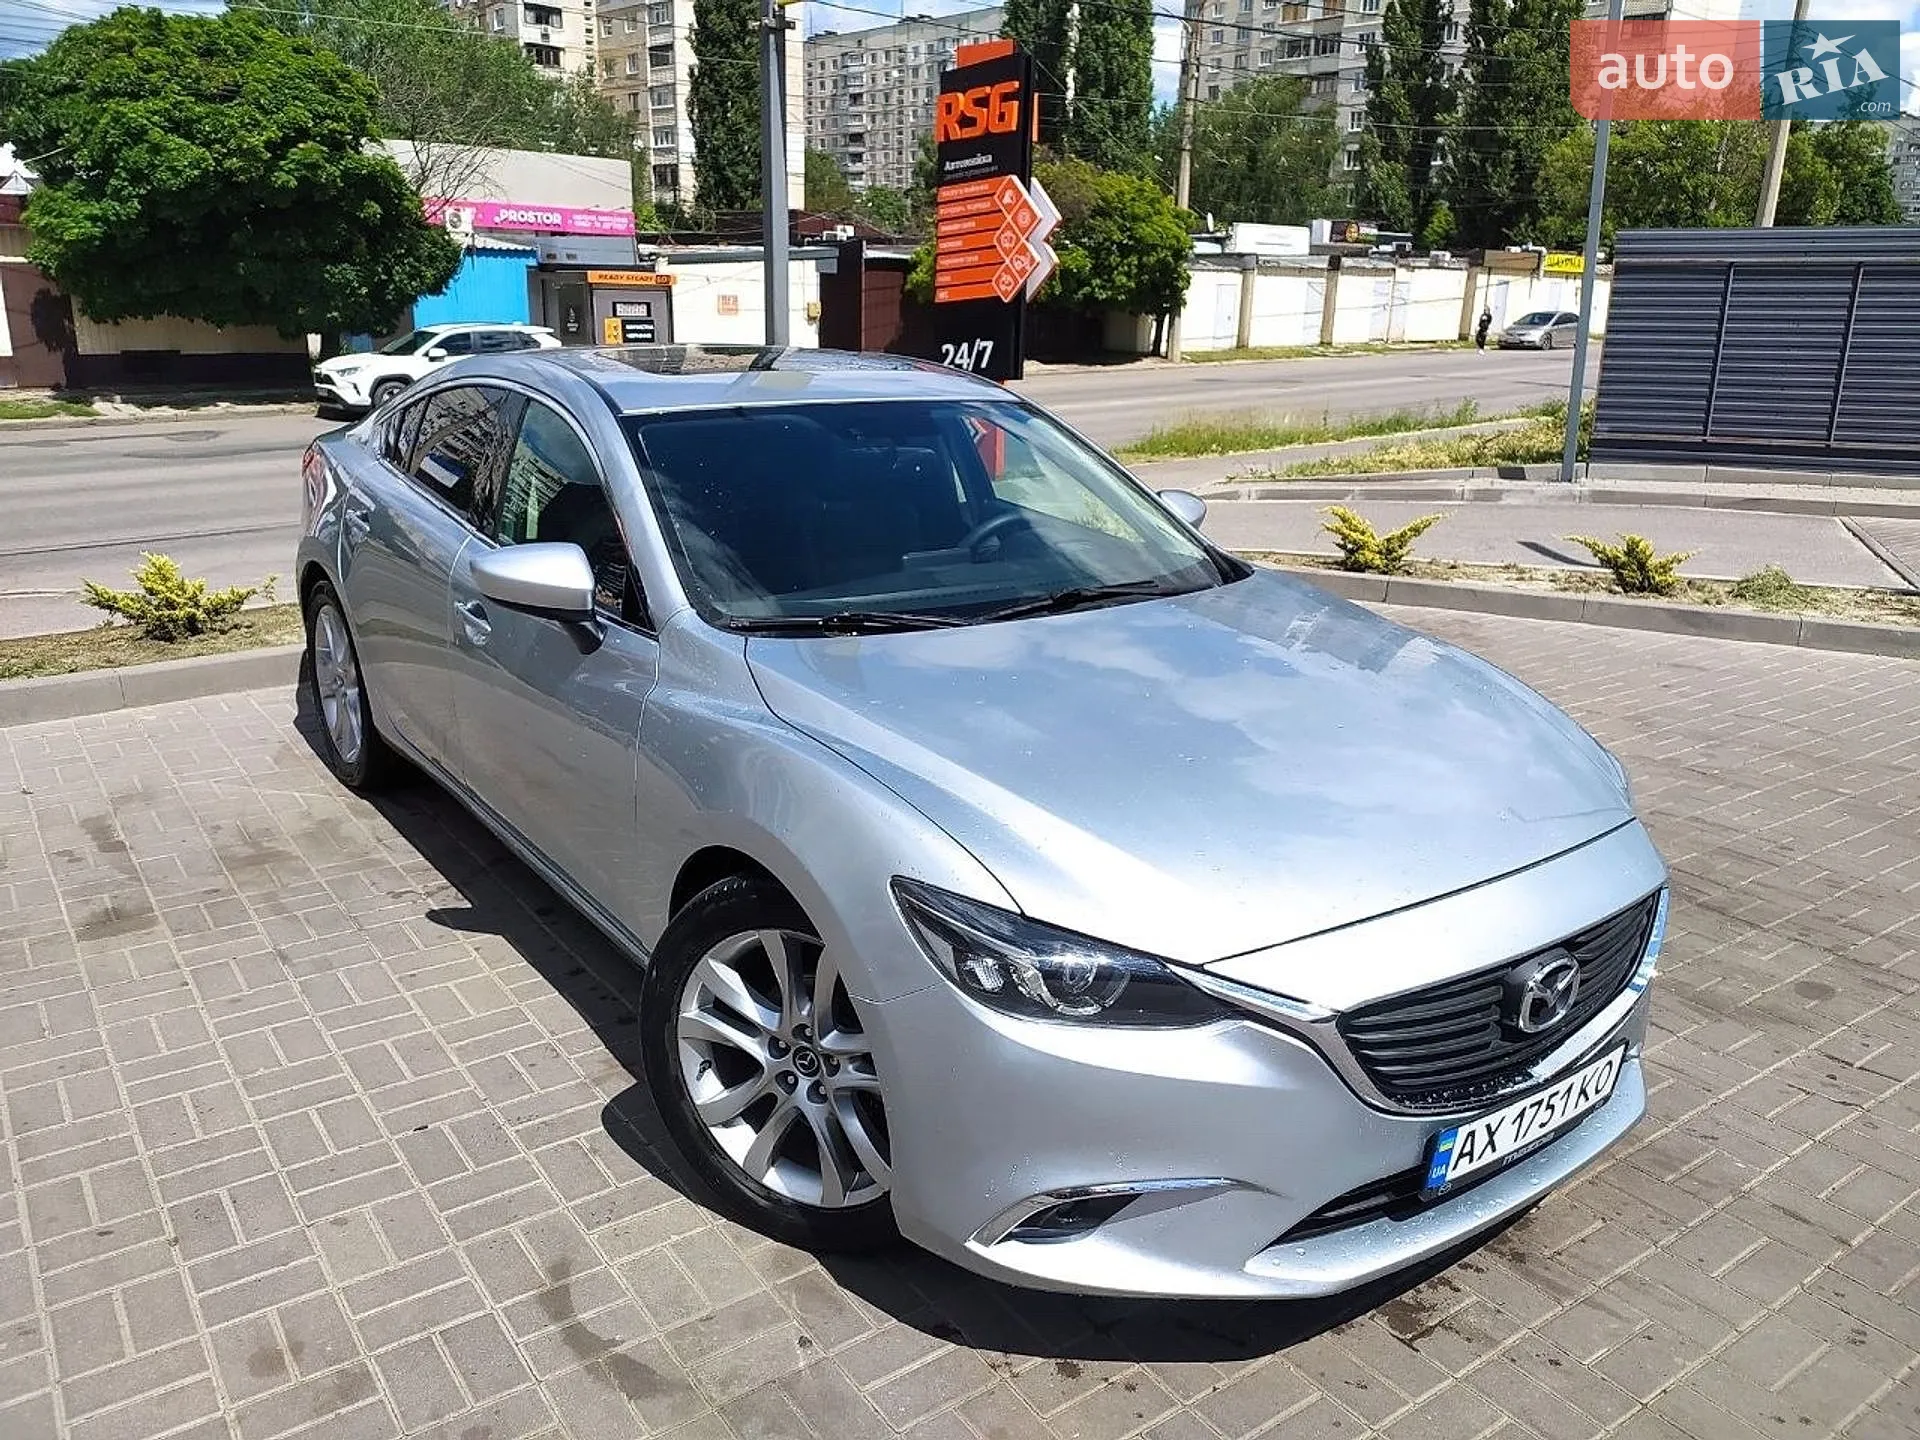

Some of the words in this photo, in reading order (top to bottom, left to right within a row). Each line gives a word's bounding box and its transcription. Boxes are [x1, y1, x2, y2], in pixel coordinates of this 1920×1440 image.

[935, 80, 1020, 142] RSG
[499, 208, 562, 226] PROSTOR
[941, 337, 994, 371] 24/7
[1452, 1116, 1506, 1172] AX
[1512, 1081, 1576, 1143] 1751
[1574, 1059, 1613, 1110] KO
[1431, 1163, 1446, 1179] UA
